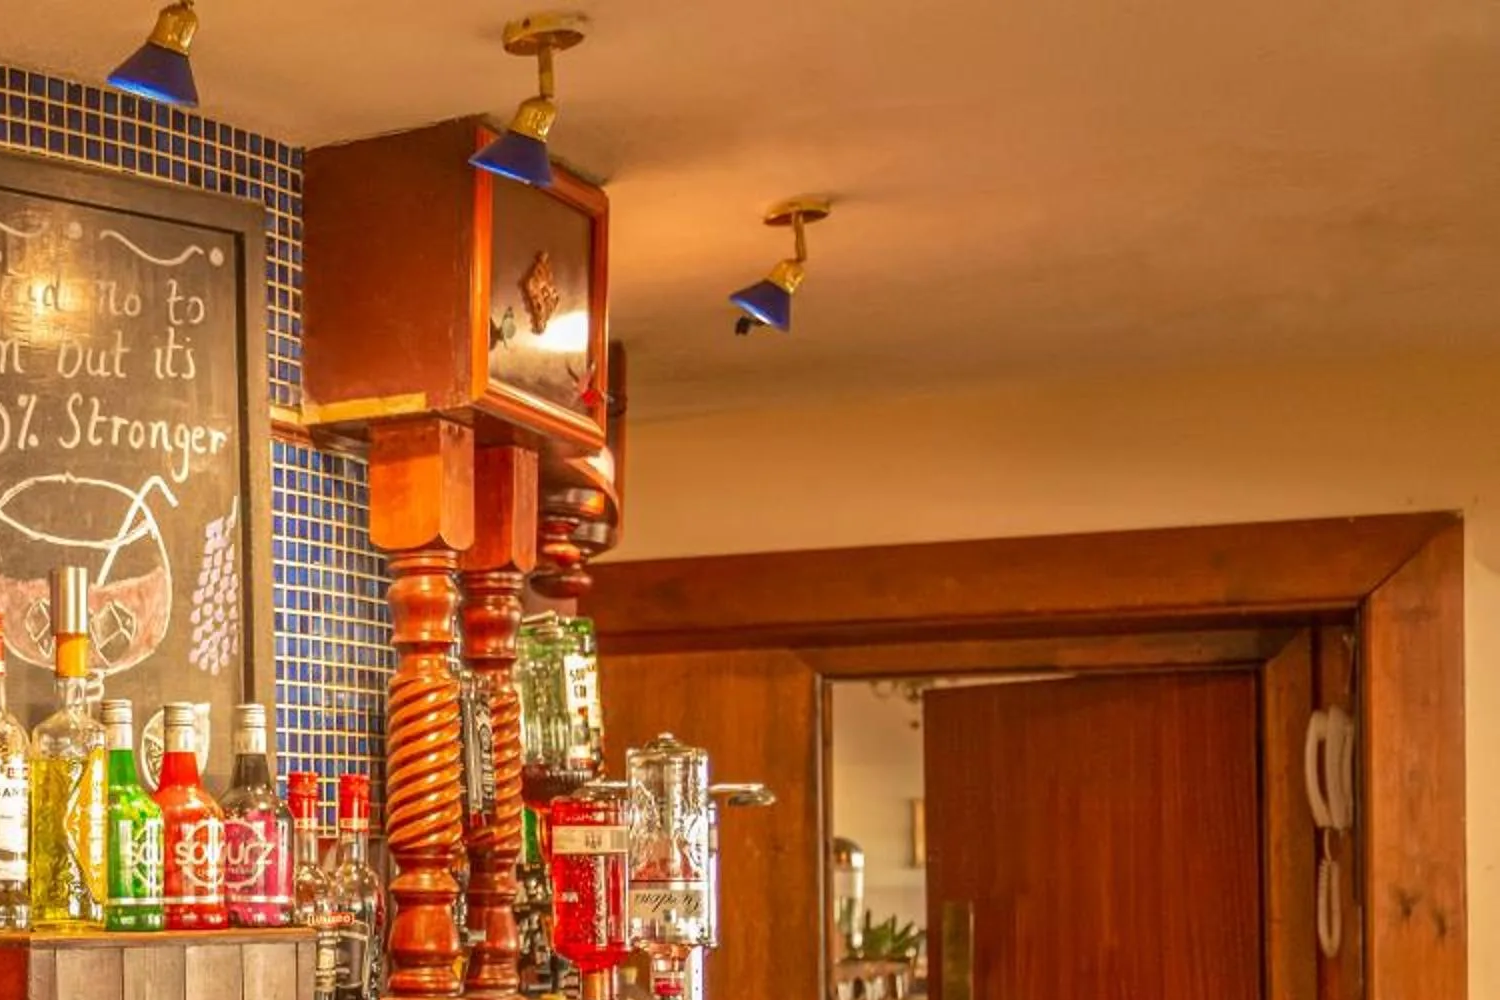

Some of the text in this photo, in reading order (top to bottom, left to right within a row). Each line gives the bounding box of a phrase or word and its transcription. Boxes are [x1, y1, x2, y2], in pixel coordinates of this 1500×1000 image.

[98, 281, 142, 317] no
[167, 277, 206, 325] to
[57, 329, 131, 379] but
[58, 391, 229, 483] Stronger
